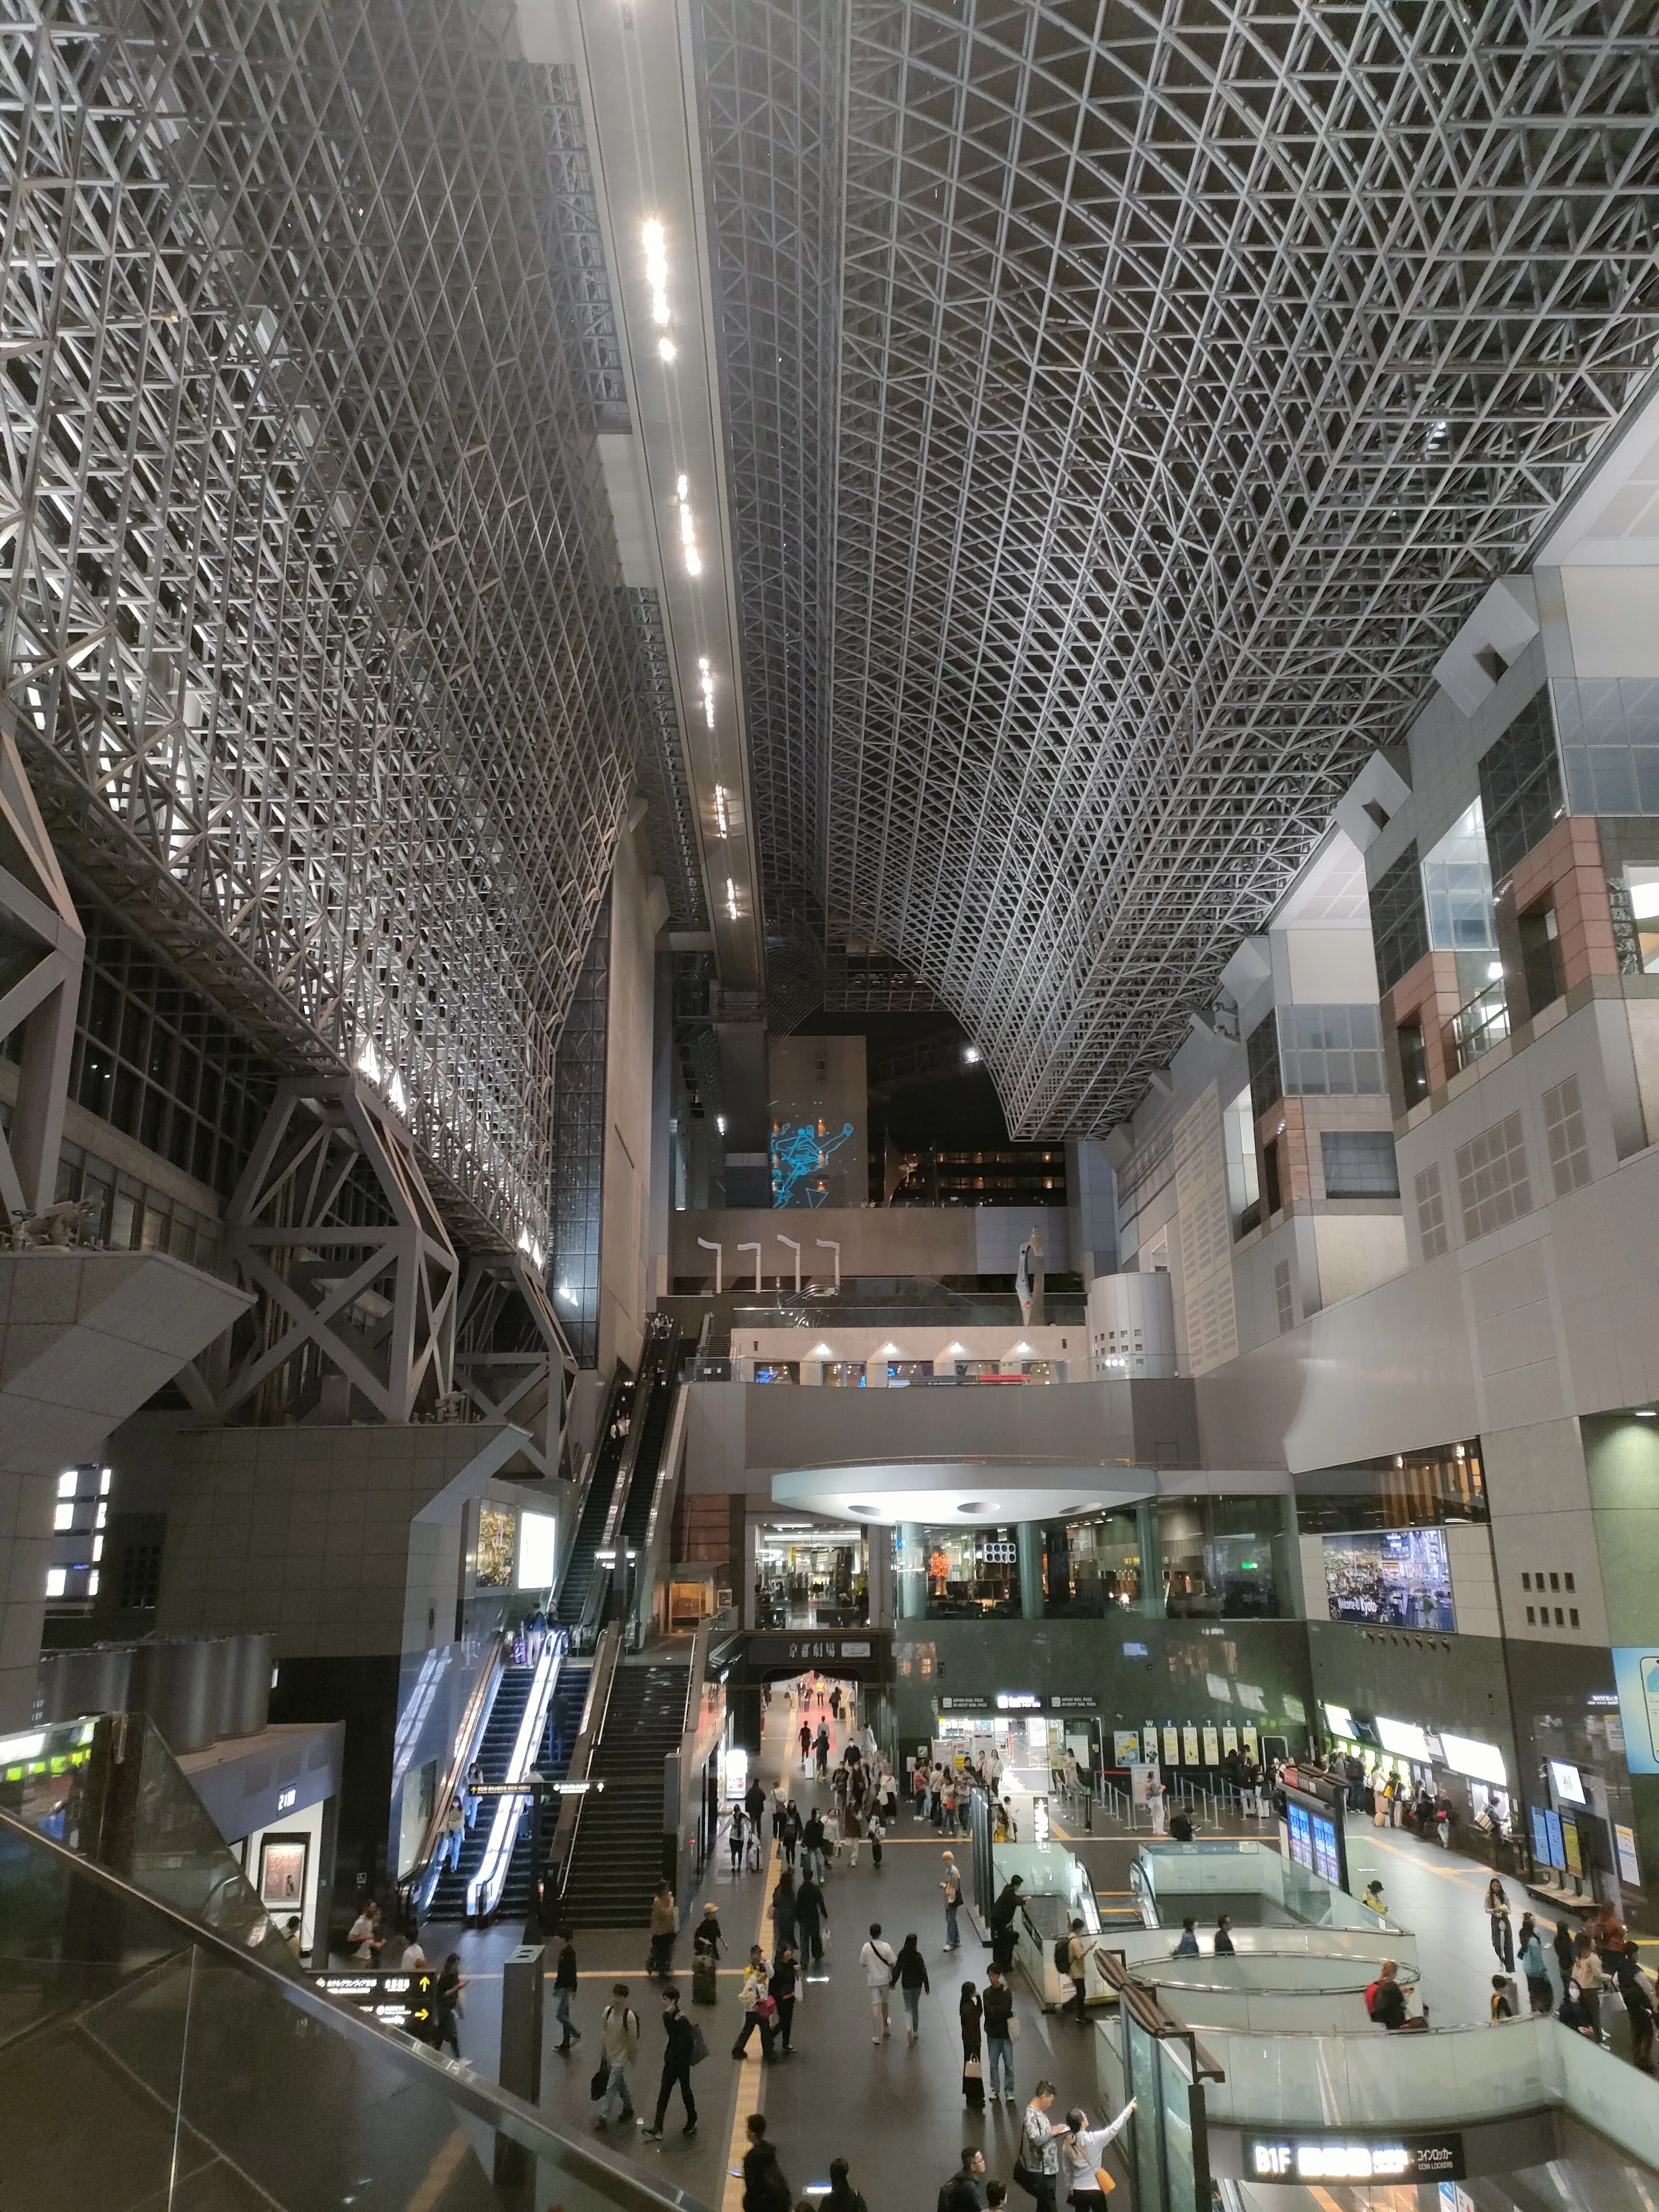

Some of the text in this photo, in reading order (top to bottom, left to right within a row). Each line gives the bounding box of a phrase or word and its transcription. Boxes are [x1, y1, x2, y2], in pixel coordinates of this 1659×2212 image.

[1338, 1597, 1355, 1610] Welcome
[1360, 1598, 1377, 1616] Kyoto
[789, 1642, 836, 1658] 京都劇場
[1255, 2146, 1291, 2173] B1F
[1417, 2147, 1453, 2161] コインロッカー
[1431, 2161, 1453, 2169] LOCKERS
